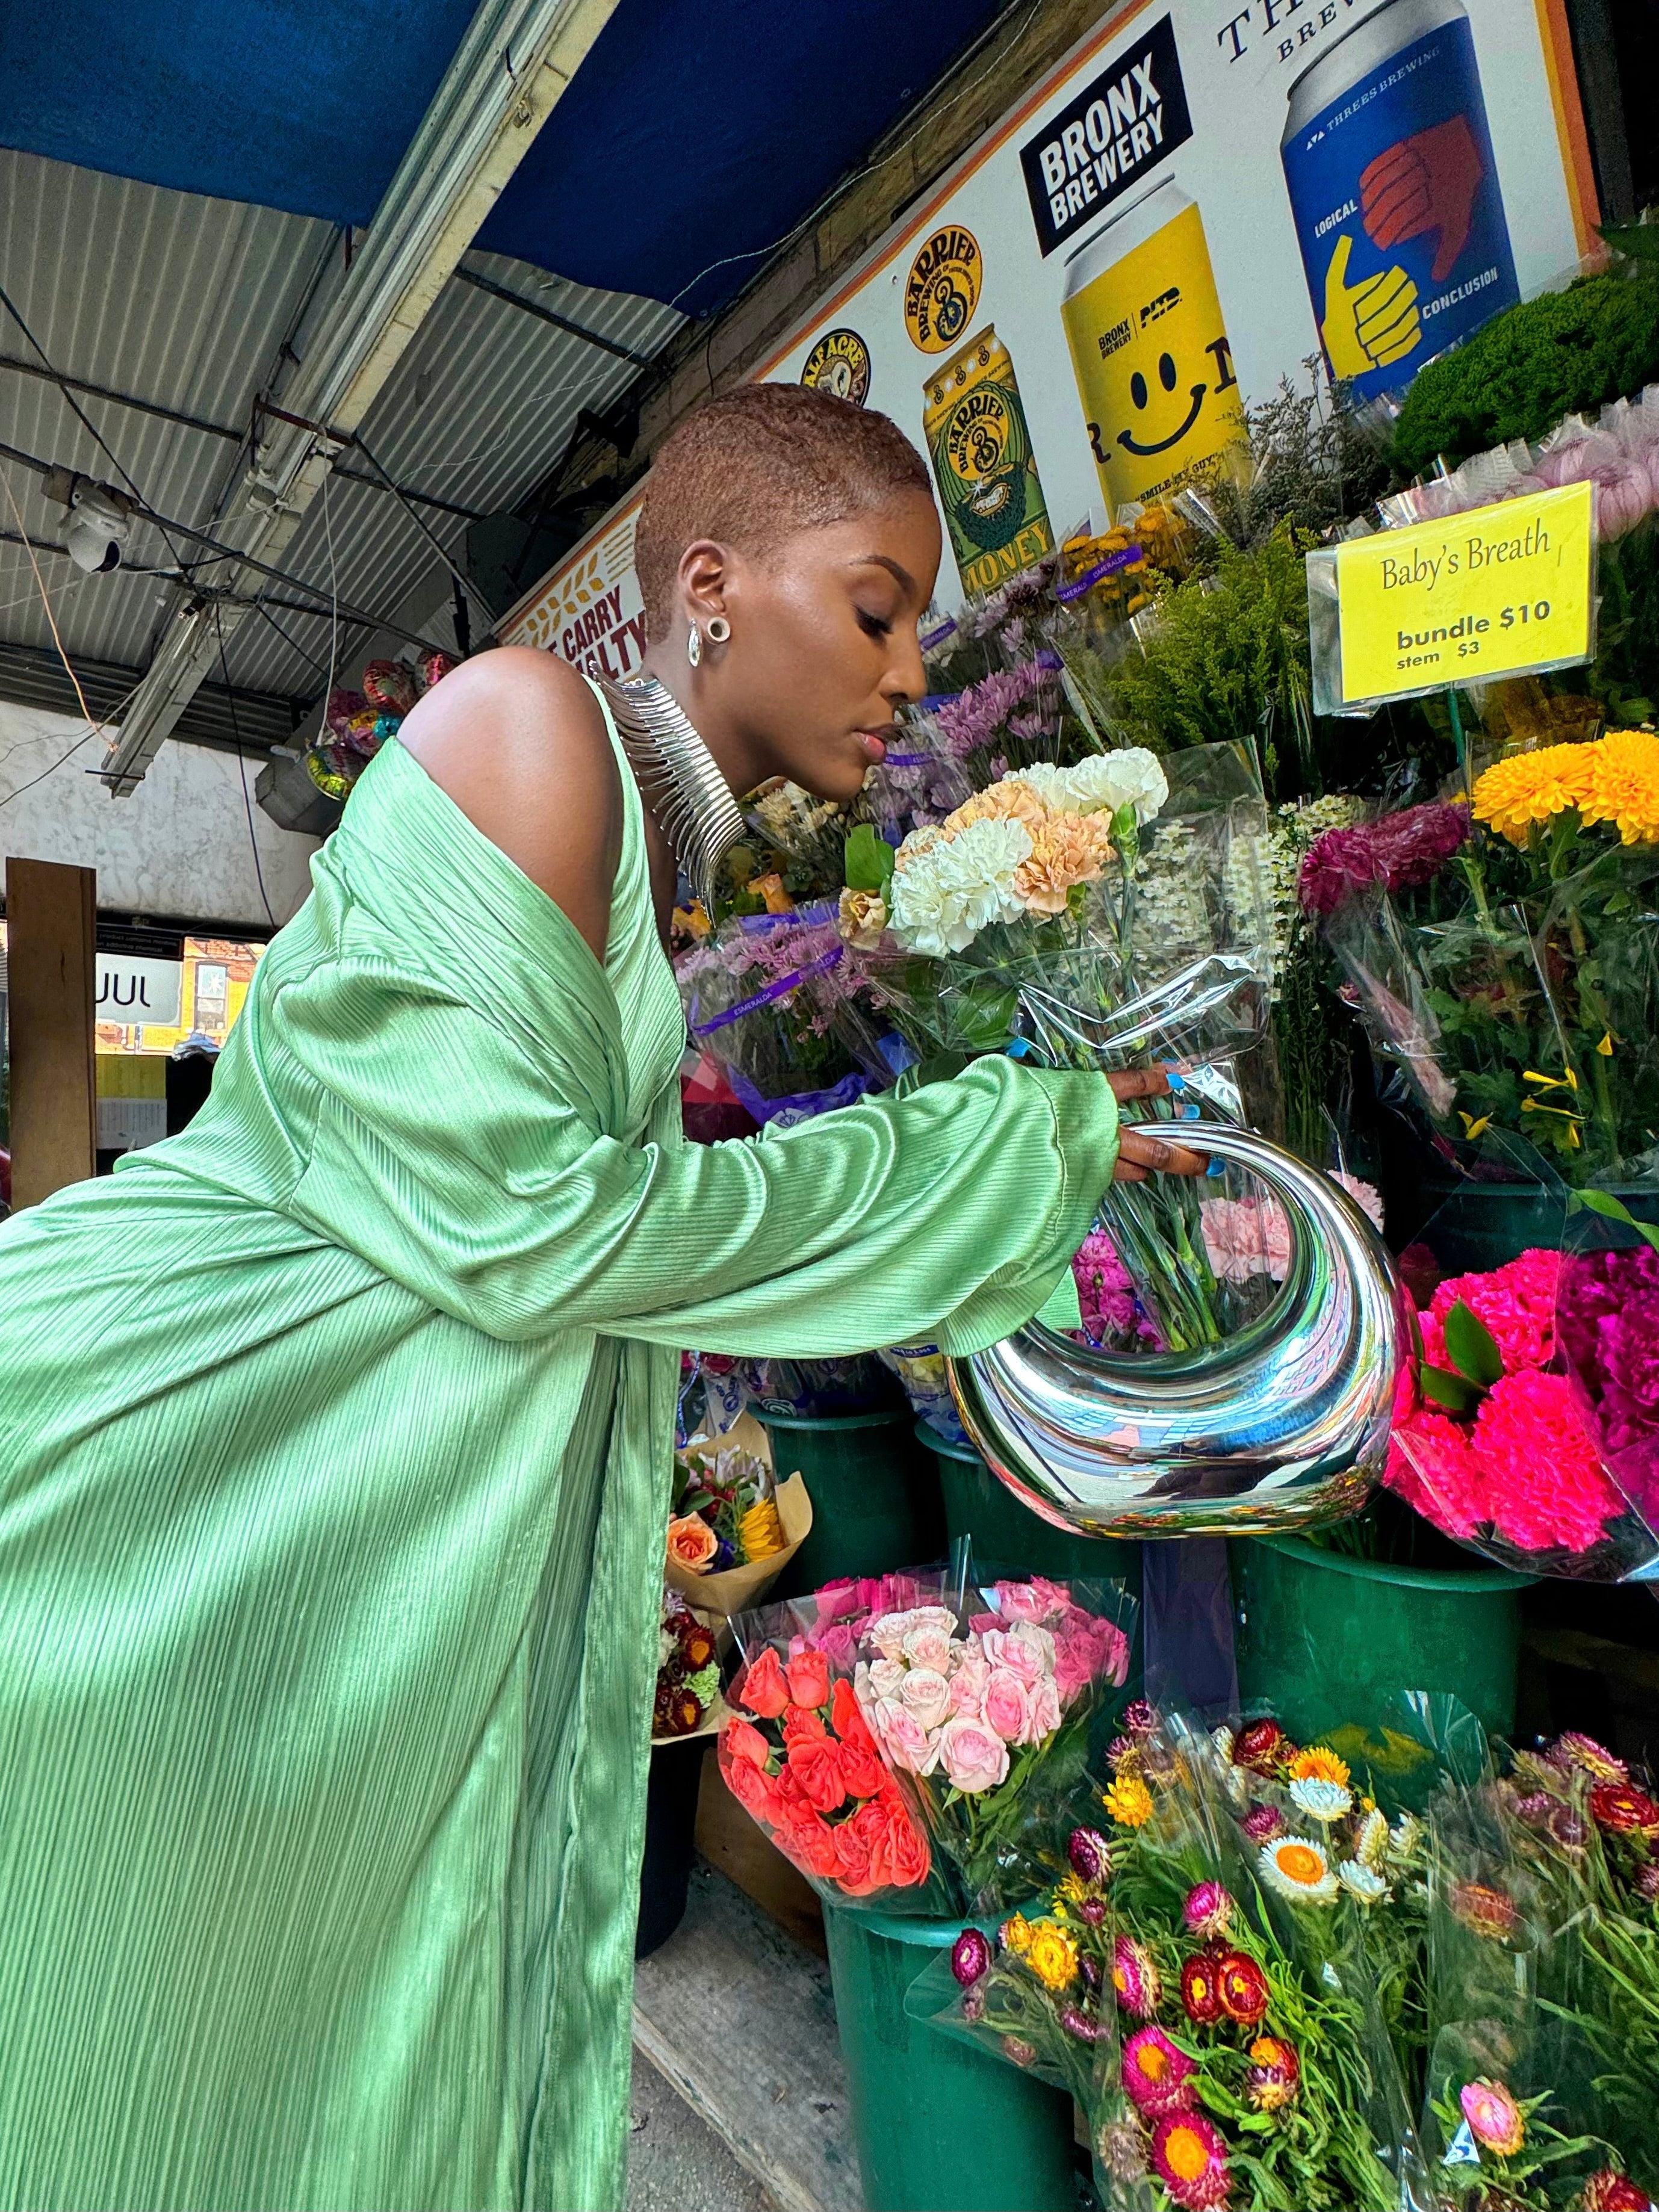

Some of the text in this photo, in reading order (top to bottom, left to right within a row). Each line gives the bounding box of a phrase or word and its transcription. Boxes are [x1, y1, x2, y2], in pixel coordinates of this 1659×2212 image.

[1277, 0, 1353, 63] BRE
[1326, 46, 1440, 131] THREES BREWING
[1040, 52, 1161, 196] BRONX
[1050, 103, 1163, 230] BREWERY
[1314, 199, 1358, 238] LOGICAL
[908, 231, 975, 317] BARRIER
[1422, 267, 1498, 320] CONCLUSION
[919, 269, 942, 343] BREWING
[1099, 318, 1130, 350] BRONX
[804, 335, 864, 388] ALF ACRE
[1101, 332, 1131, 359] BREWERY
[949, 394, 1004, 454] BARRIER
[1380, 517, 1551, 591] Baby's Breath
[562, 584, 622, 662] CARRY
[575, 610, 647, 680] ALTY
[1397, 600, 1551, 650] bundle $10
[1397, 641, 1480, 670] stem $3
[96, 973, 150, 1008] UUL
[733, 991, 772, 1016] ESMERALDA
